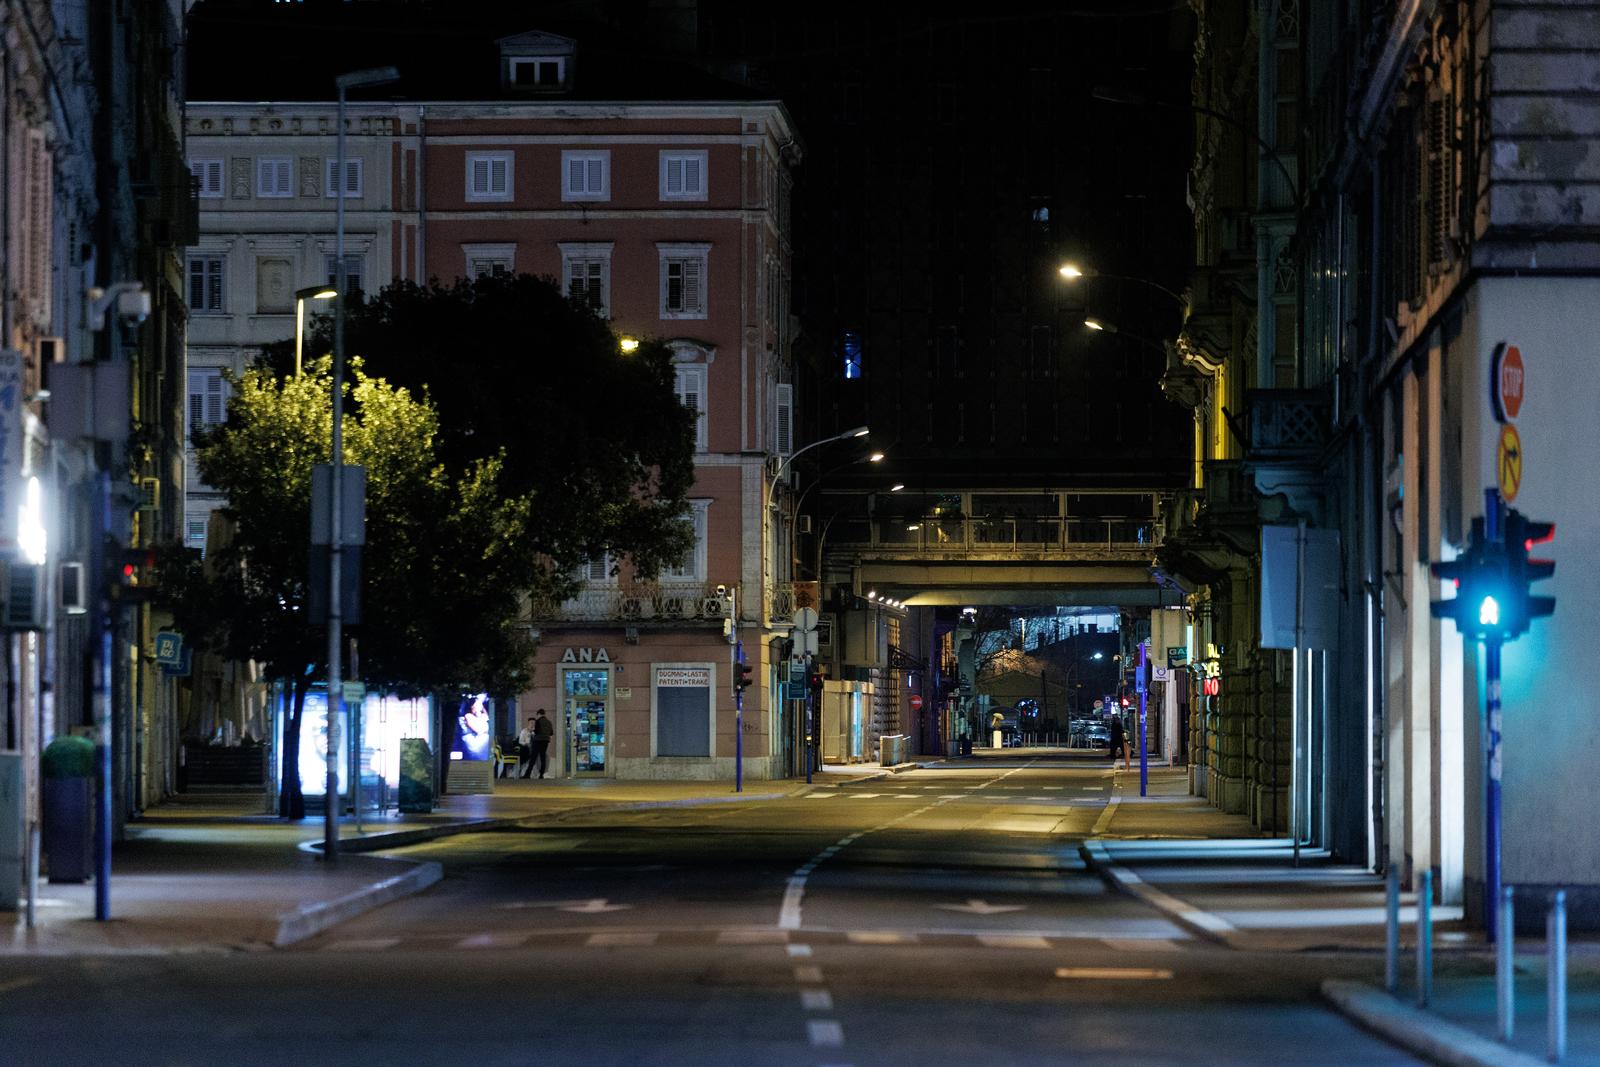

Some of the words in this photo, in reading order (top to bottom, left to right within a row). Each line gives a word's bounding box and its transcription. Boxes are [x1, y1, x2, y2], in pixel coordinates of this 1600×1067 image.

[1503, 367, 1522, 397] STOP
[561, 647, 609, 663] ANA
[687, 678, 708, 686] TRAKE
